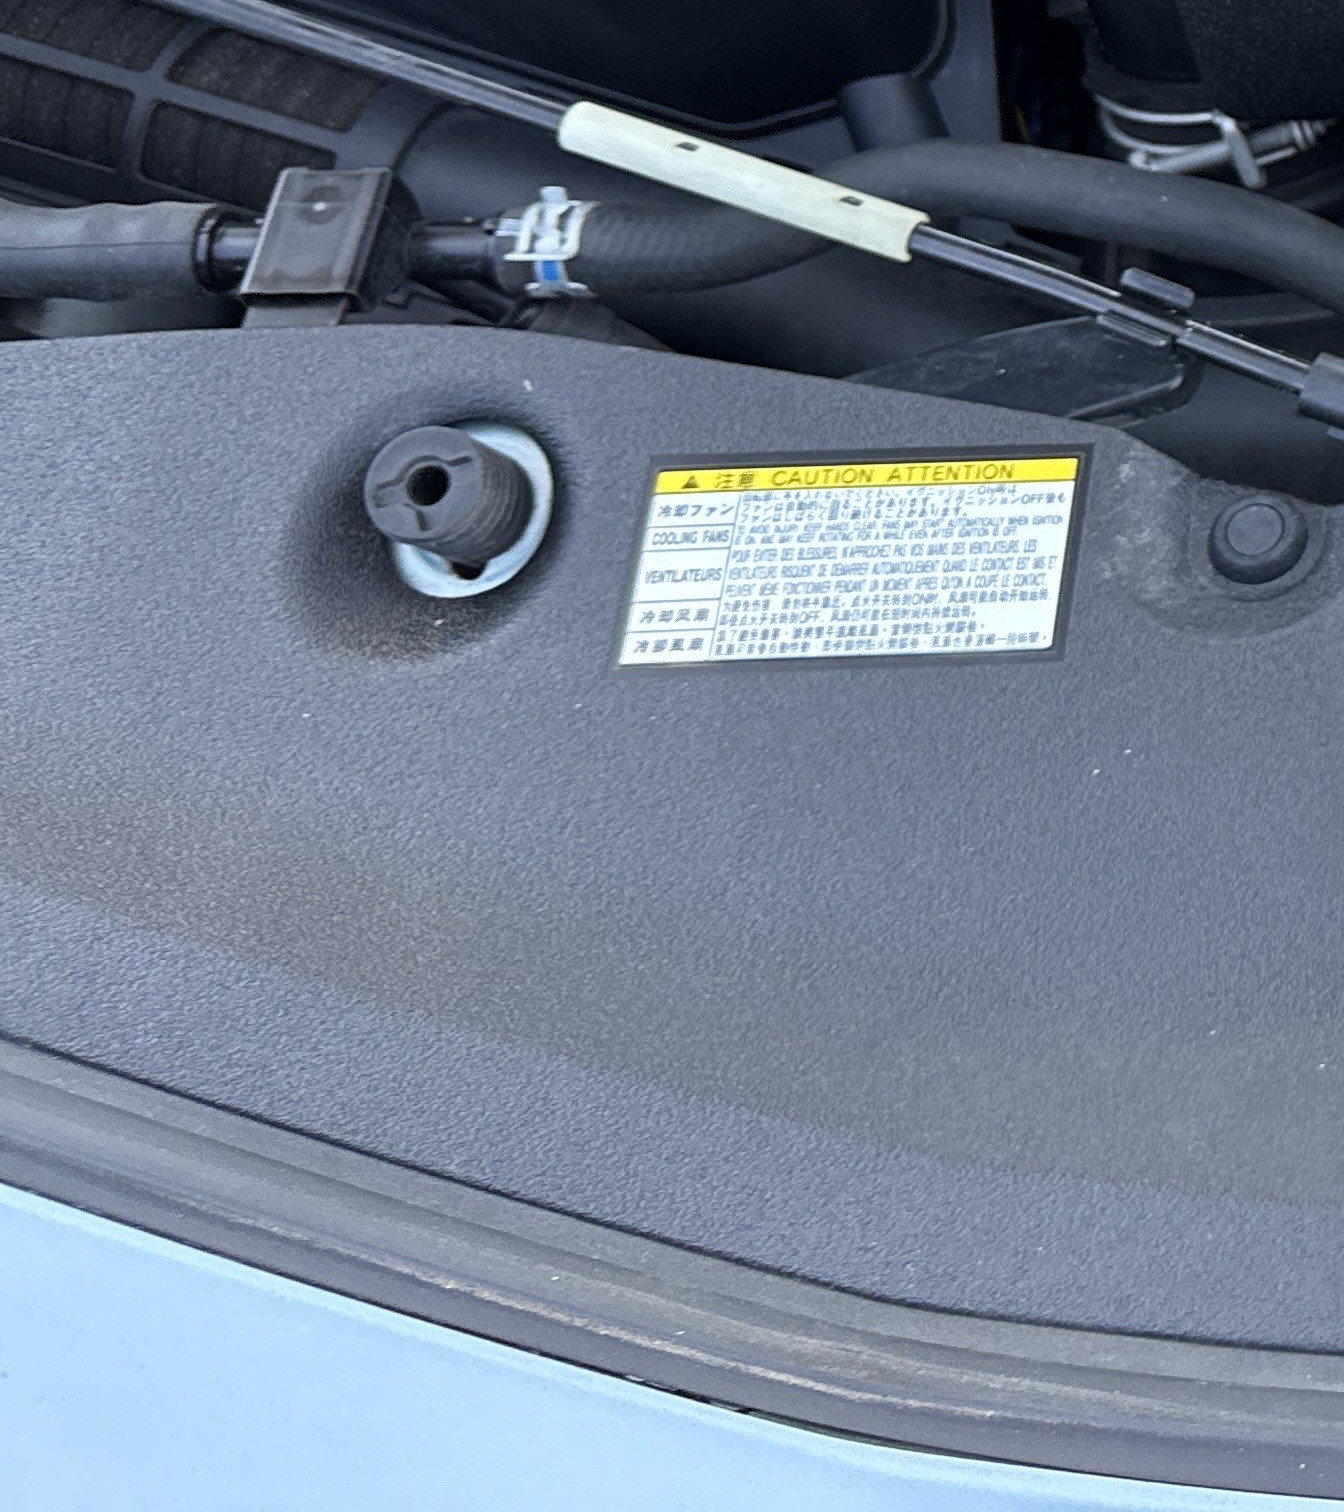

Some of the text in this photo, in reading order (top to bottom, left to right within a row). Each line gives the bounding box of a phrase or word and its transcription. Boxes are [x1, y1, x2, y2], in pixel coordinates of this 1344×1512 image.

[770, 463, 1014, 486] CAUTION ATTENTION
[652, 530, 729, 544] COOLING FANS
[645, 568, 722, 582] VENTILATEURS
